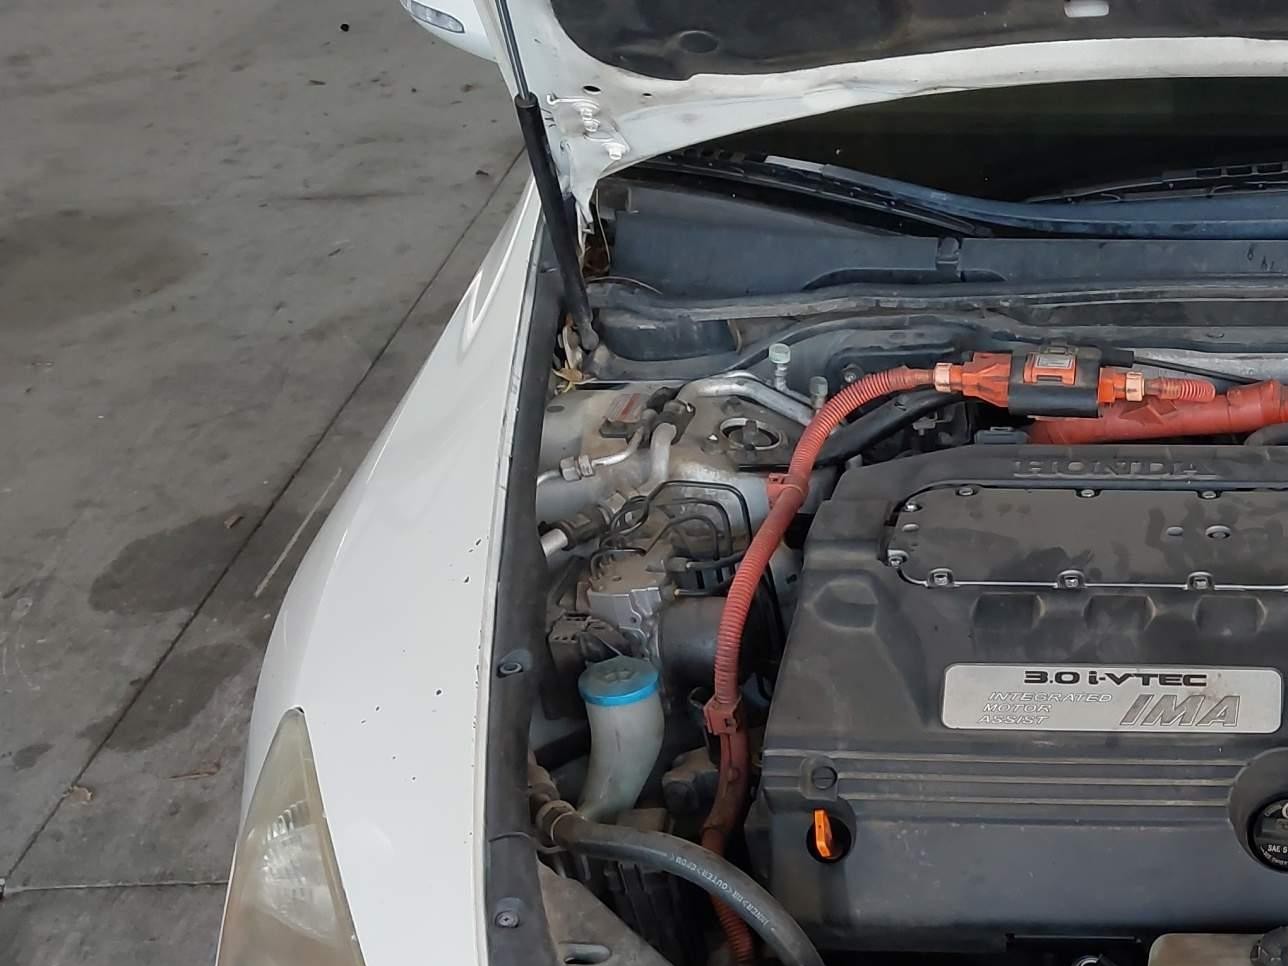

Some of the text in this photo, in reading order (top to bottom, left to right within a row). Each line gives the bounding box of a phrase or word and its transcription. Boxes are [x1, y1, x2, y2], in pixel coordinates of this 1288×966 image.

[1024, 671, 1207, 686] 3.0 i-VTEC
[989, 692, 1113, 703] INTEGRATED
[983, 703, 1052, 713] MOTOR
[1120, 694, 1241, 727] IMA
[977, 715, 1049, 724] ASSIST
[1267, 844, 1281, 853] SAE
